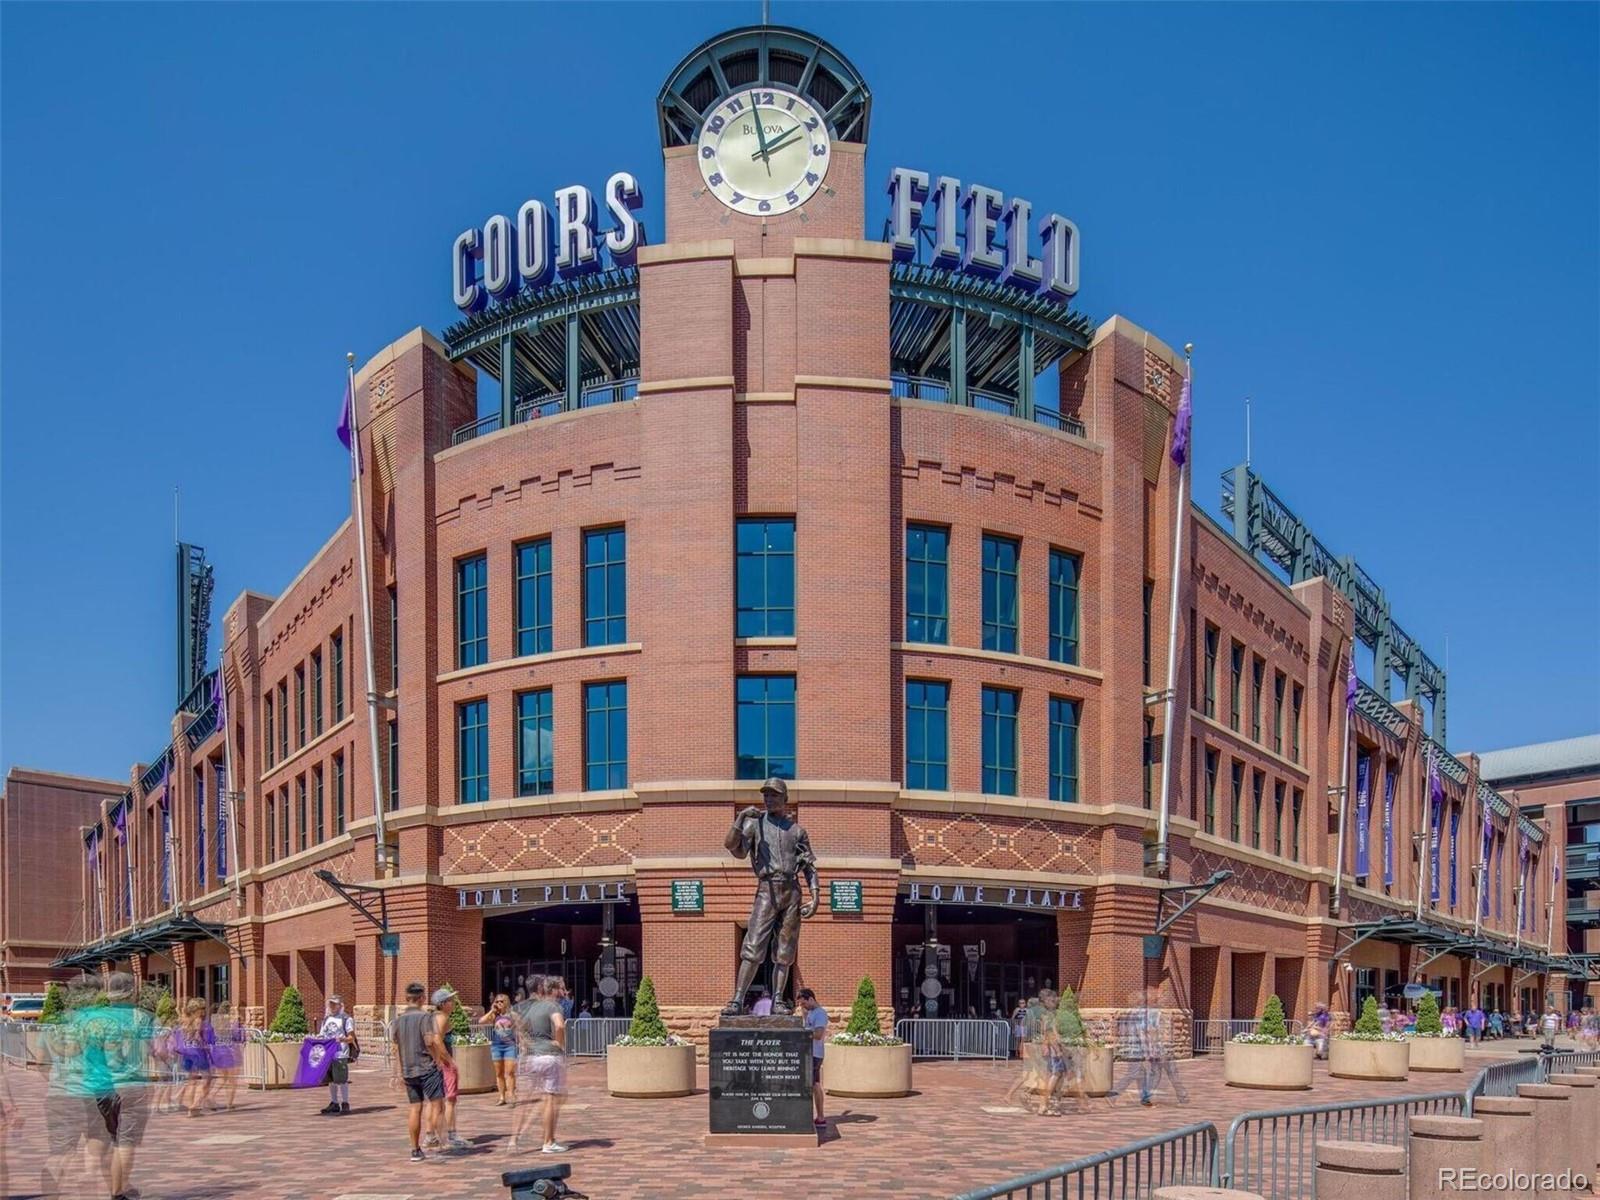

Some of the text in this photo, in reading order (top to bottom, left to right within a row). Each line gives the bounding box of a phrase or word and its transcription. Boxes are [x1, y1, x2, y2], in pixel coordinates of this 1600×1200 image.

[727, 98, 744, 114] 11
[753, 92, 775, 105] 12
[786, 97, 796, 111] 1
[707, 115, 725, 135] 10
[743, 124, 784, 136] BUOVA
[804, 117, 819, 132] 2
[702, 146, 715, 159] 9
[813, 144, 826, 157] 3
[709, 172, 724, 187] 8
[805, 171, 819, 187] 4
[730, 191, 745, 205] 7
[785, 190, 799, 206] 5
[758, 200, 771, 212] 6
[453, 167, 1081, 309] COORS FIELD
[459, 883, 627, 909] HOME PLATE
[910, 883, 1081, 908] HOME PLATE
